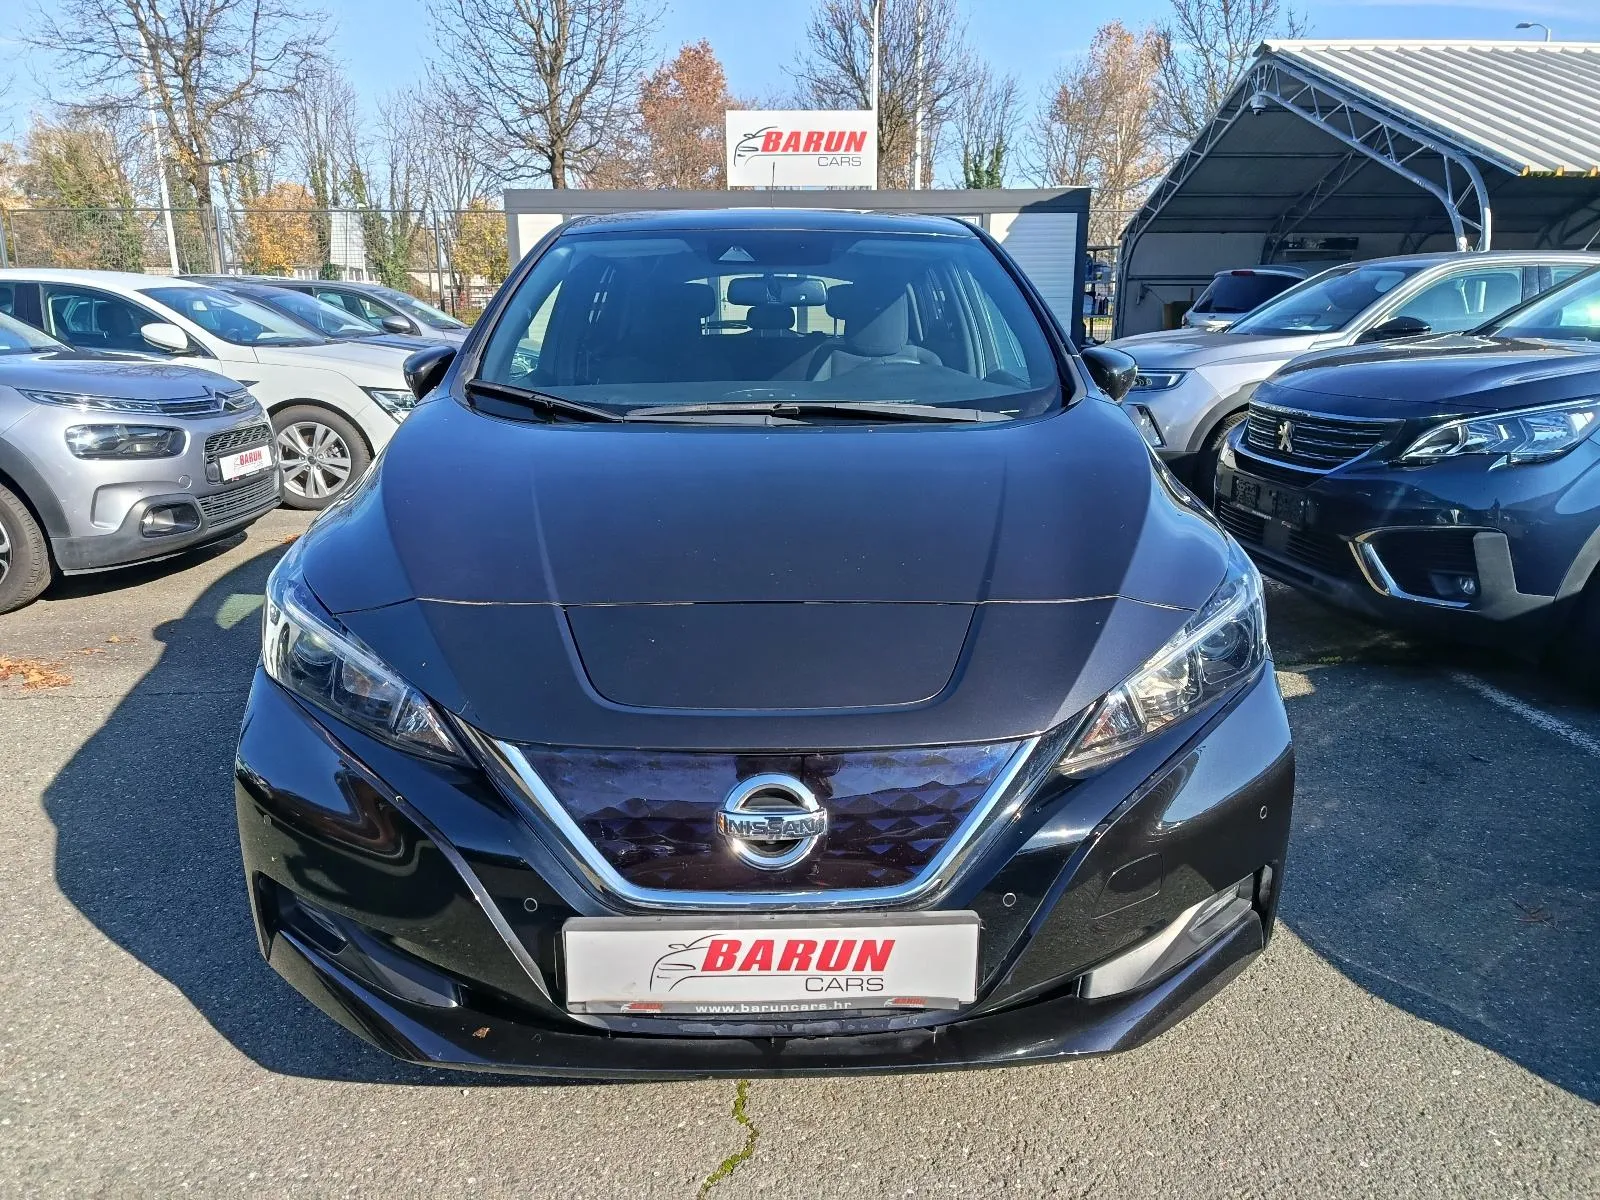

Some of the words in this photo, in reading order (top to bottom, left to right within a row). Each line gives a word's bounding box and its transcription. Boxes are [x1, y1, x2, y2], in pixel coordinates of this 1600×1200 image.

[761, 131, 868, 152] BARUN
[817, 156, 862, 167] CARS
[728, 819, 817, 835] NISSAN
[701, 939, 896, 972] BARUN
[804, 976, 885, 992] CARS
[695, 1001, 852, 1013] www.baruncars.hr
